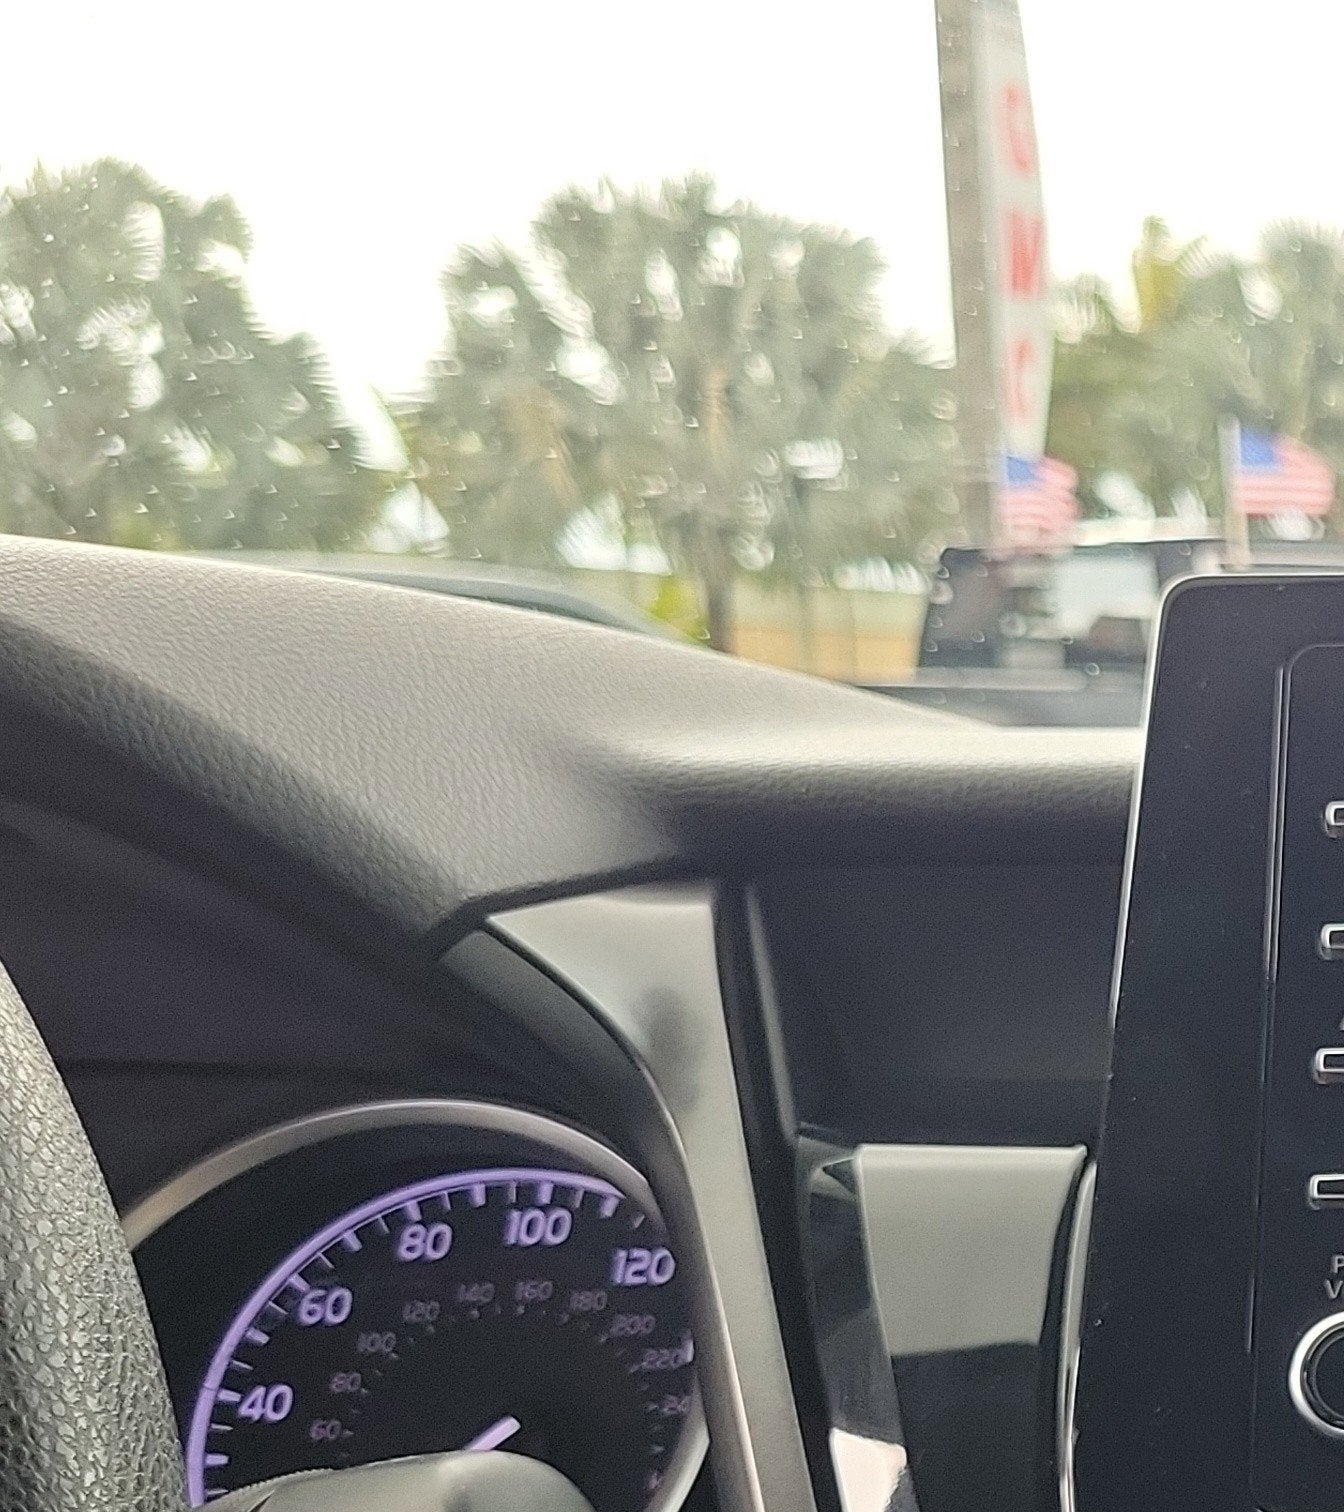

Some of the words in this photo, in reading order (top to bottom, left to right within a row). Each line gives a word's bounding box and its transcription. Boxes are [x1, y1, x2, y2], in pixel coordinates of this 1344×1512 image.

[397, 1223, 452, 1260] 80
[506, 1208, 571, 1245] 100
[613, 1248, 675, 1285] 120
[299, 1287, 353, 1325] 60
[516, 1281, 553, 1301] 160
[332, 1372, 362, 1393] 80
[238, 1384, 293, 1422] 40
[310, 1420, 342, 1440] 60
